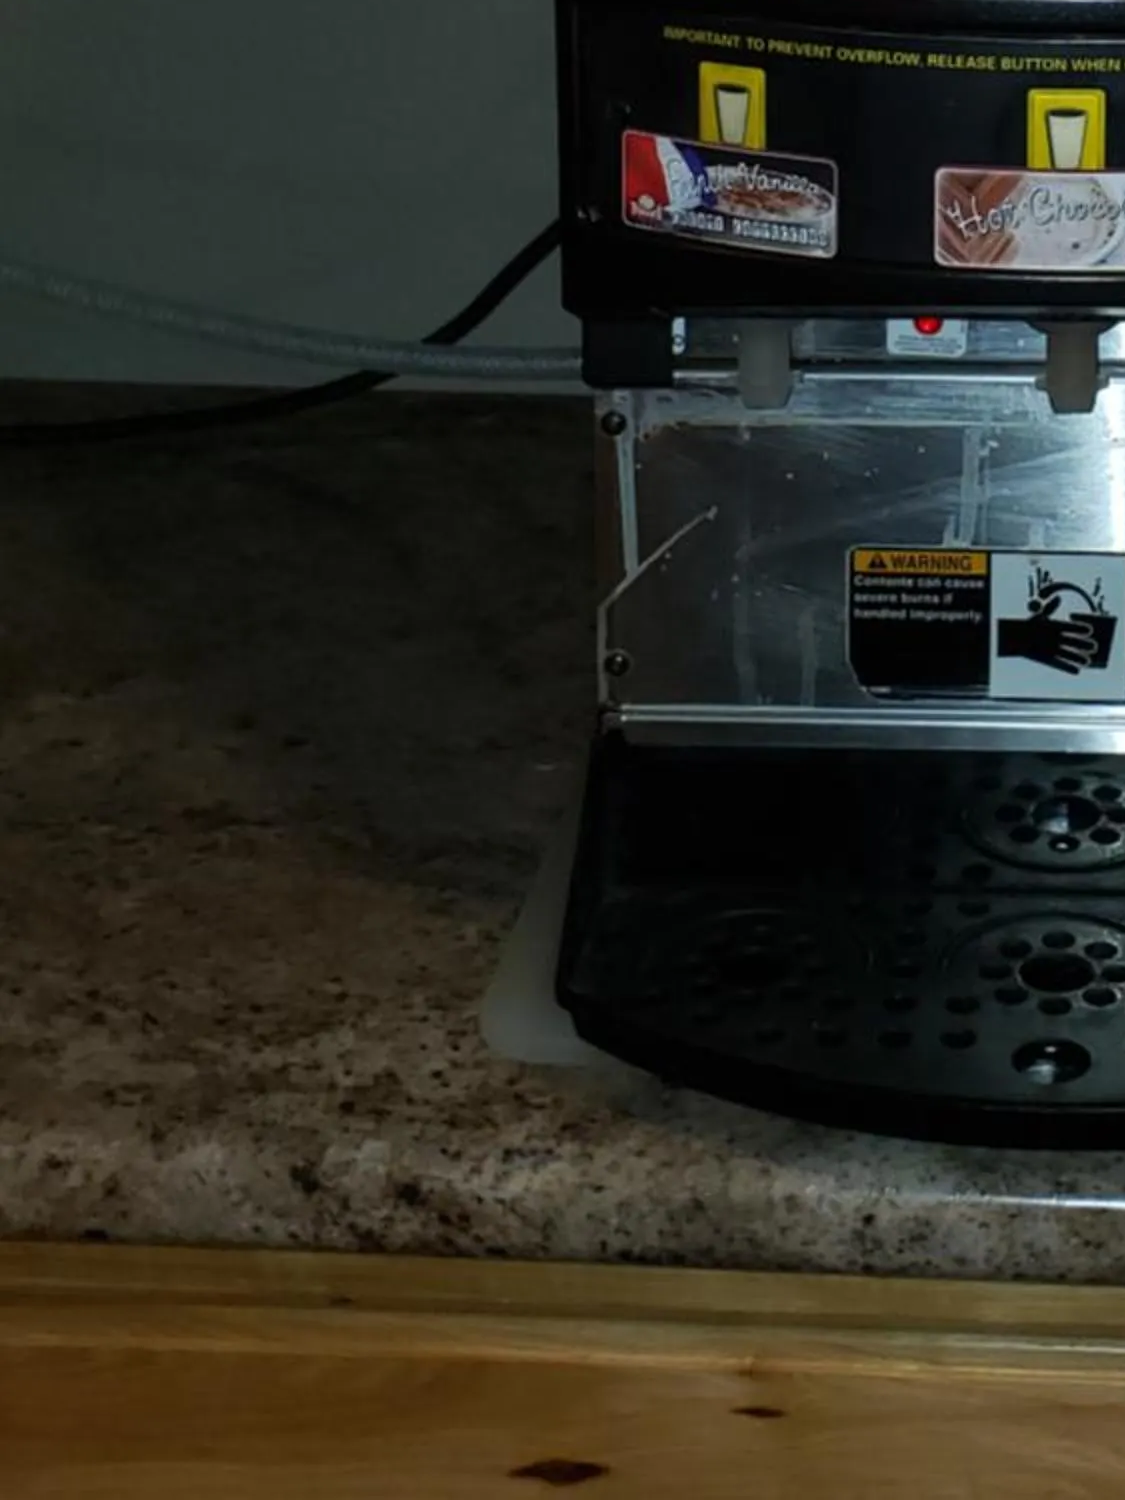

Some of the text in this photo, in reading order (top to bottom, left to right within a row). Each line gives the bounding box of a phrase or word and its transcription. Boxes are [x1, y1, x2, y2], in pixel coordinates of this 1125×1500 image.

[663, 25, 741, 50] IMPORTANT
[746, 36, 766, 52] TO
[767, 38, 834, 60] PREVENT
[926, 52, 997, 71] RELEASE
[1000, 56, 1068, 73] BUTTON
[1070, 56, 1121, 73] WHEN
[940, 195, 1021, 238] Hot
[890, 553, 973, 571] WARNING
